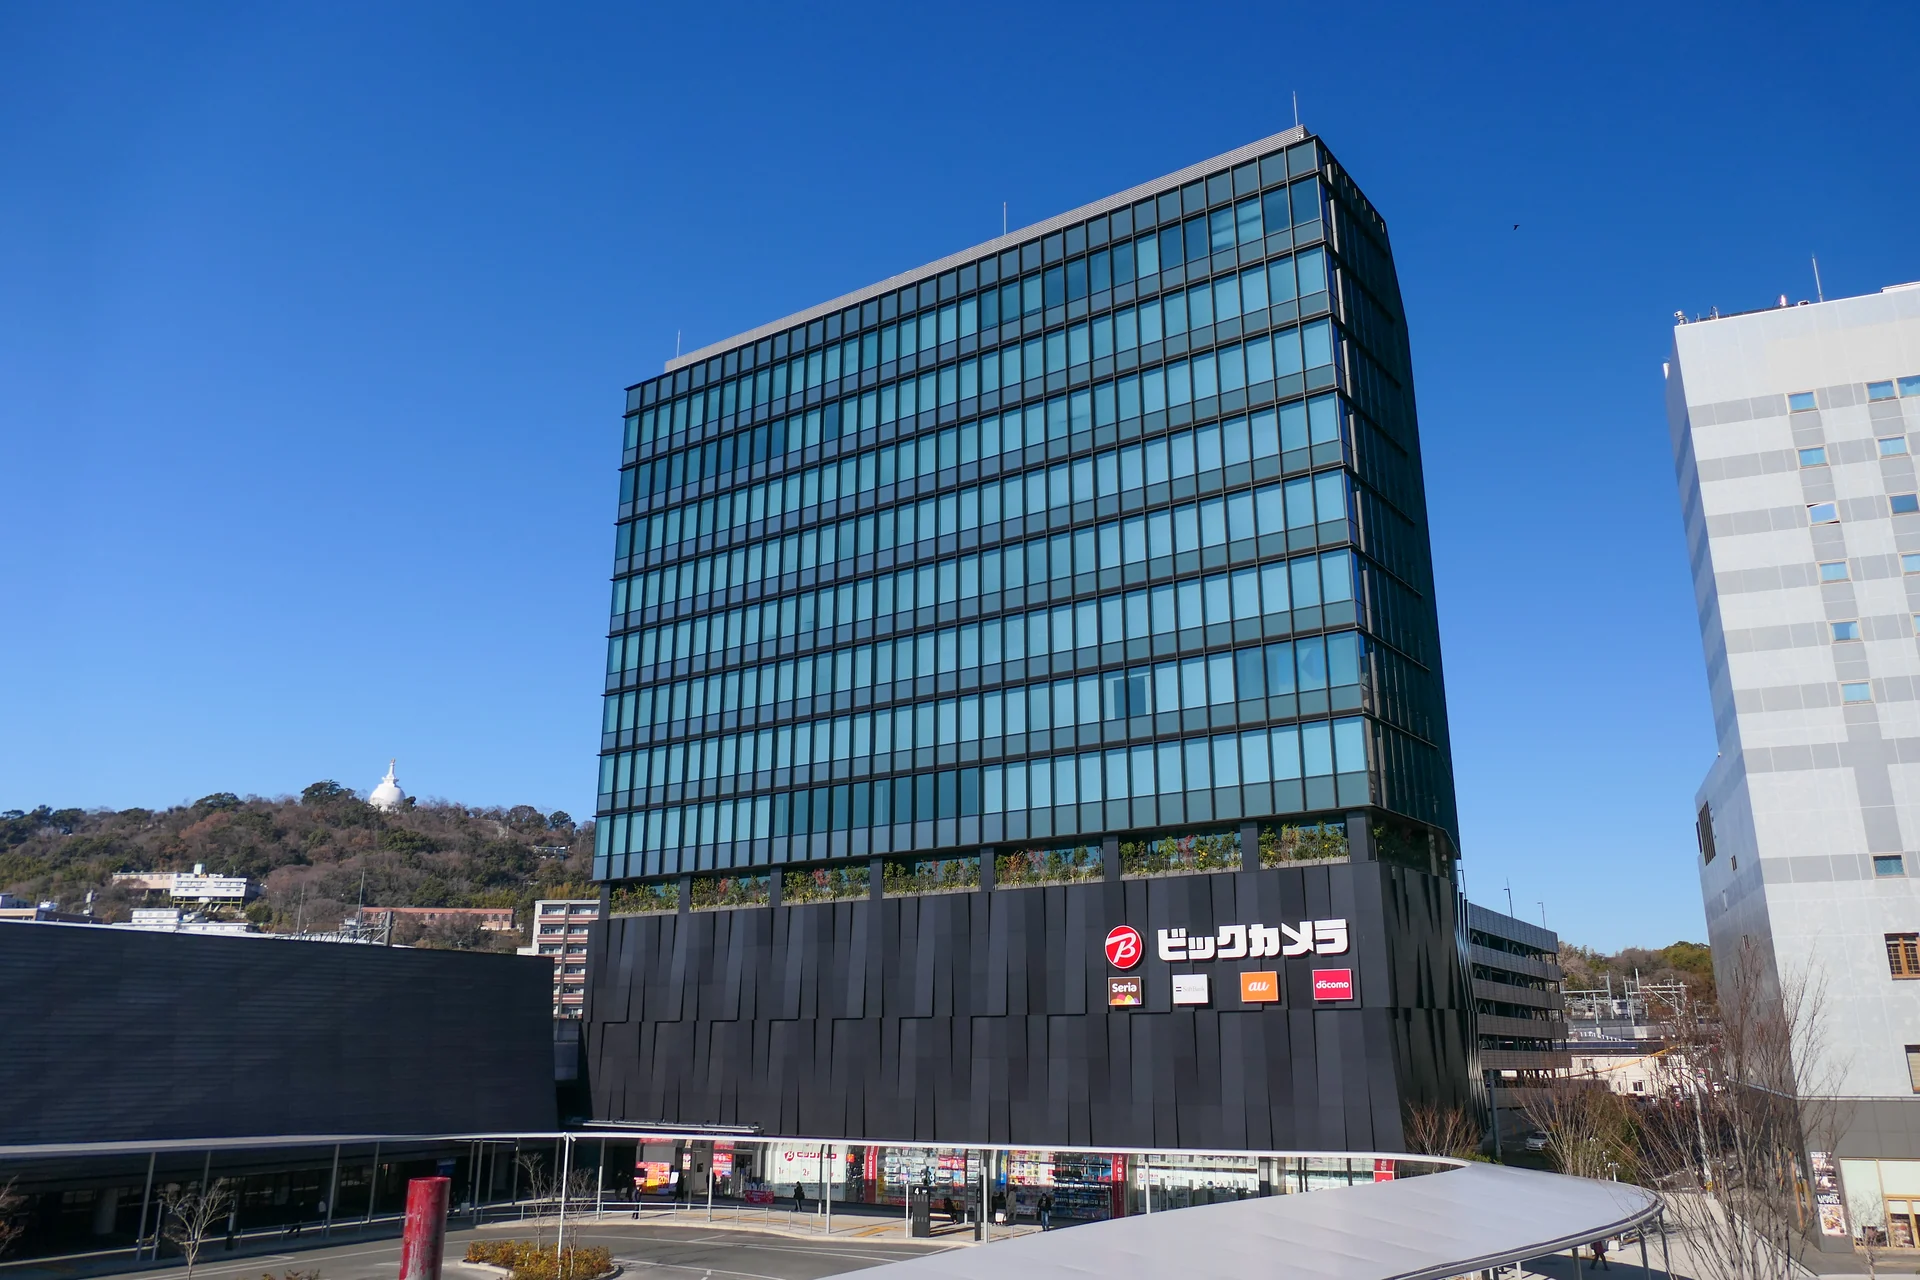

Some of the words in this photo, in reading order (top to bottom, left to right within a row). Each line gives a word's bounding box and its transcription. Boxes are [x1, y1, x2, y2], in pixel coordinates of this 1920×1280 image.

[1157, 919, 1349, 961] ビックカメラ
[1112, 982, 1137, 993] Seria
[1183, 985, 1205, 993] SoftBank
[1248, 981, 1270, 992] au
[1315, 980, 1349, 989] docomo
